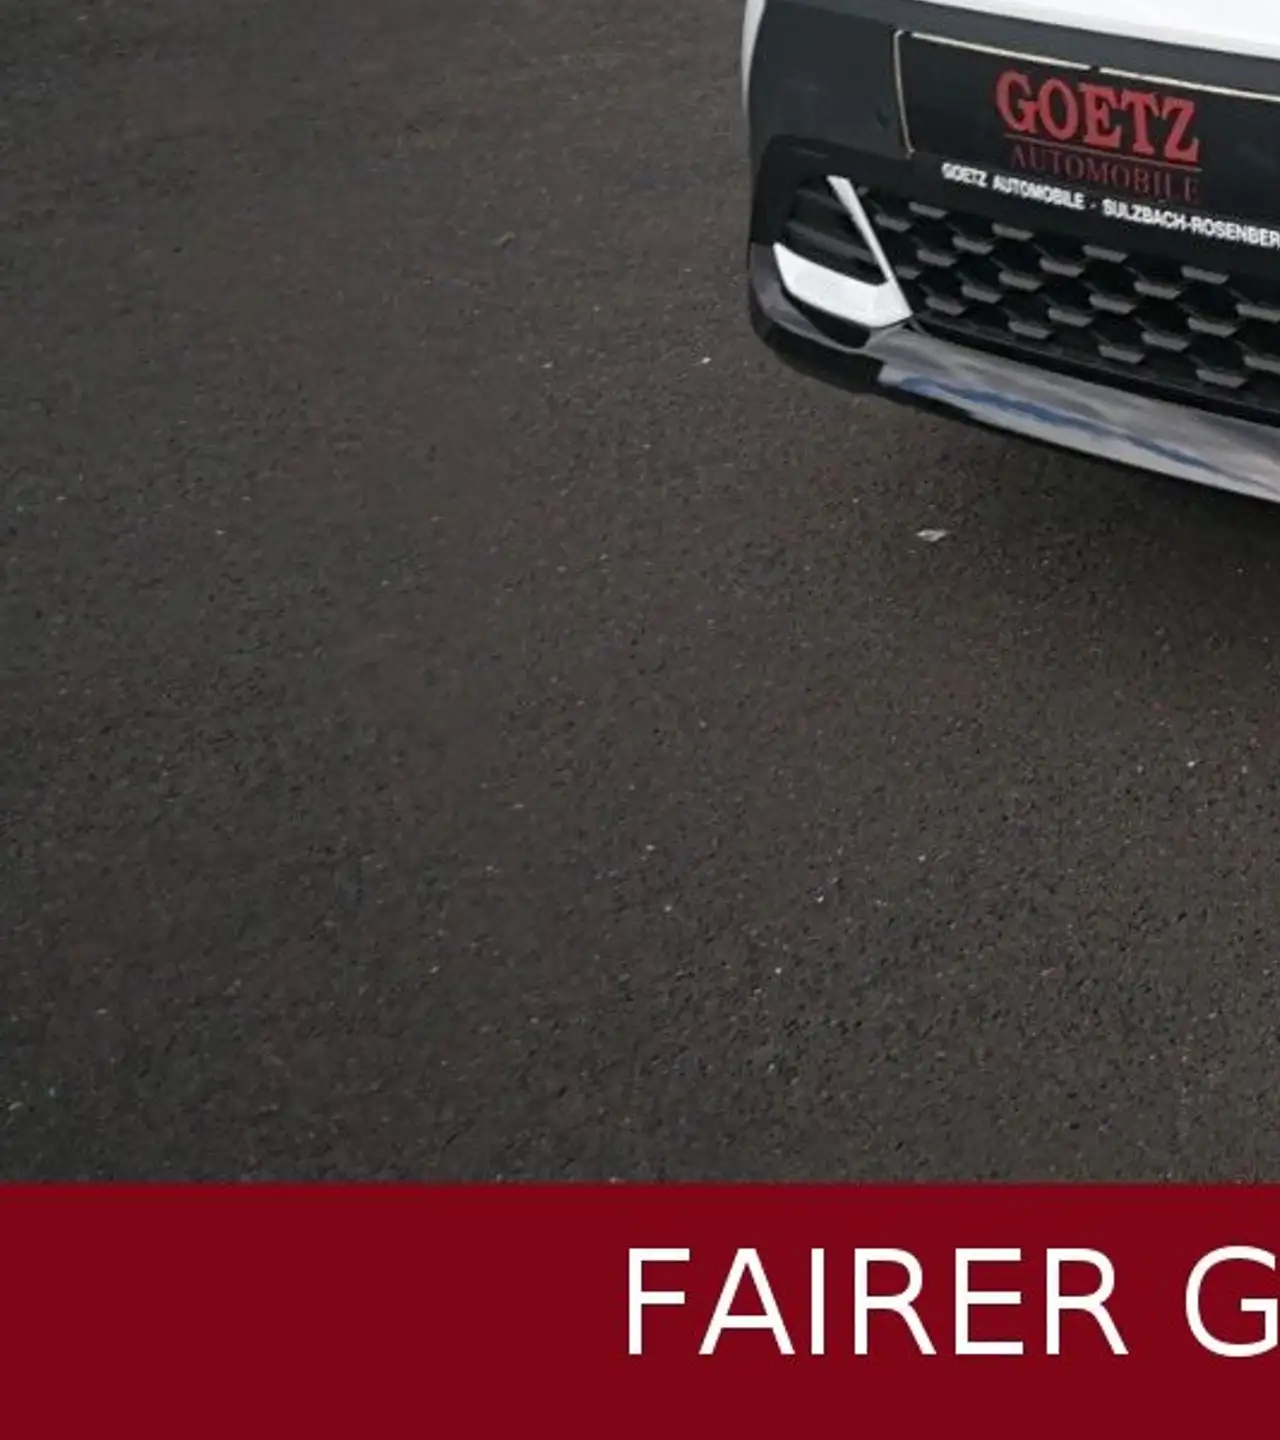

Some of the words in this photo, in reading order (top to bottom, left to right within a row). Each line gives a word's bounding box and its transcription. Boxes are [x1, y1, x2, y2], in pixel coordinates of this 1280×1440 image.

[994, 68, 1200, 164] GOETZ
[941, 162, 988, 189] GOETZ
[992, 172, 1086, 210] AUTOMOBILE
[1009, 144, 1201, 202] AUTOMOBILE
